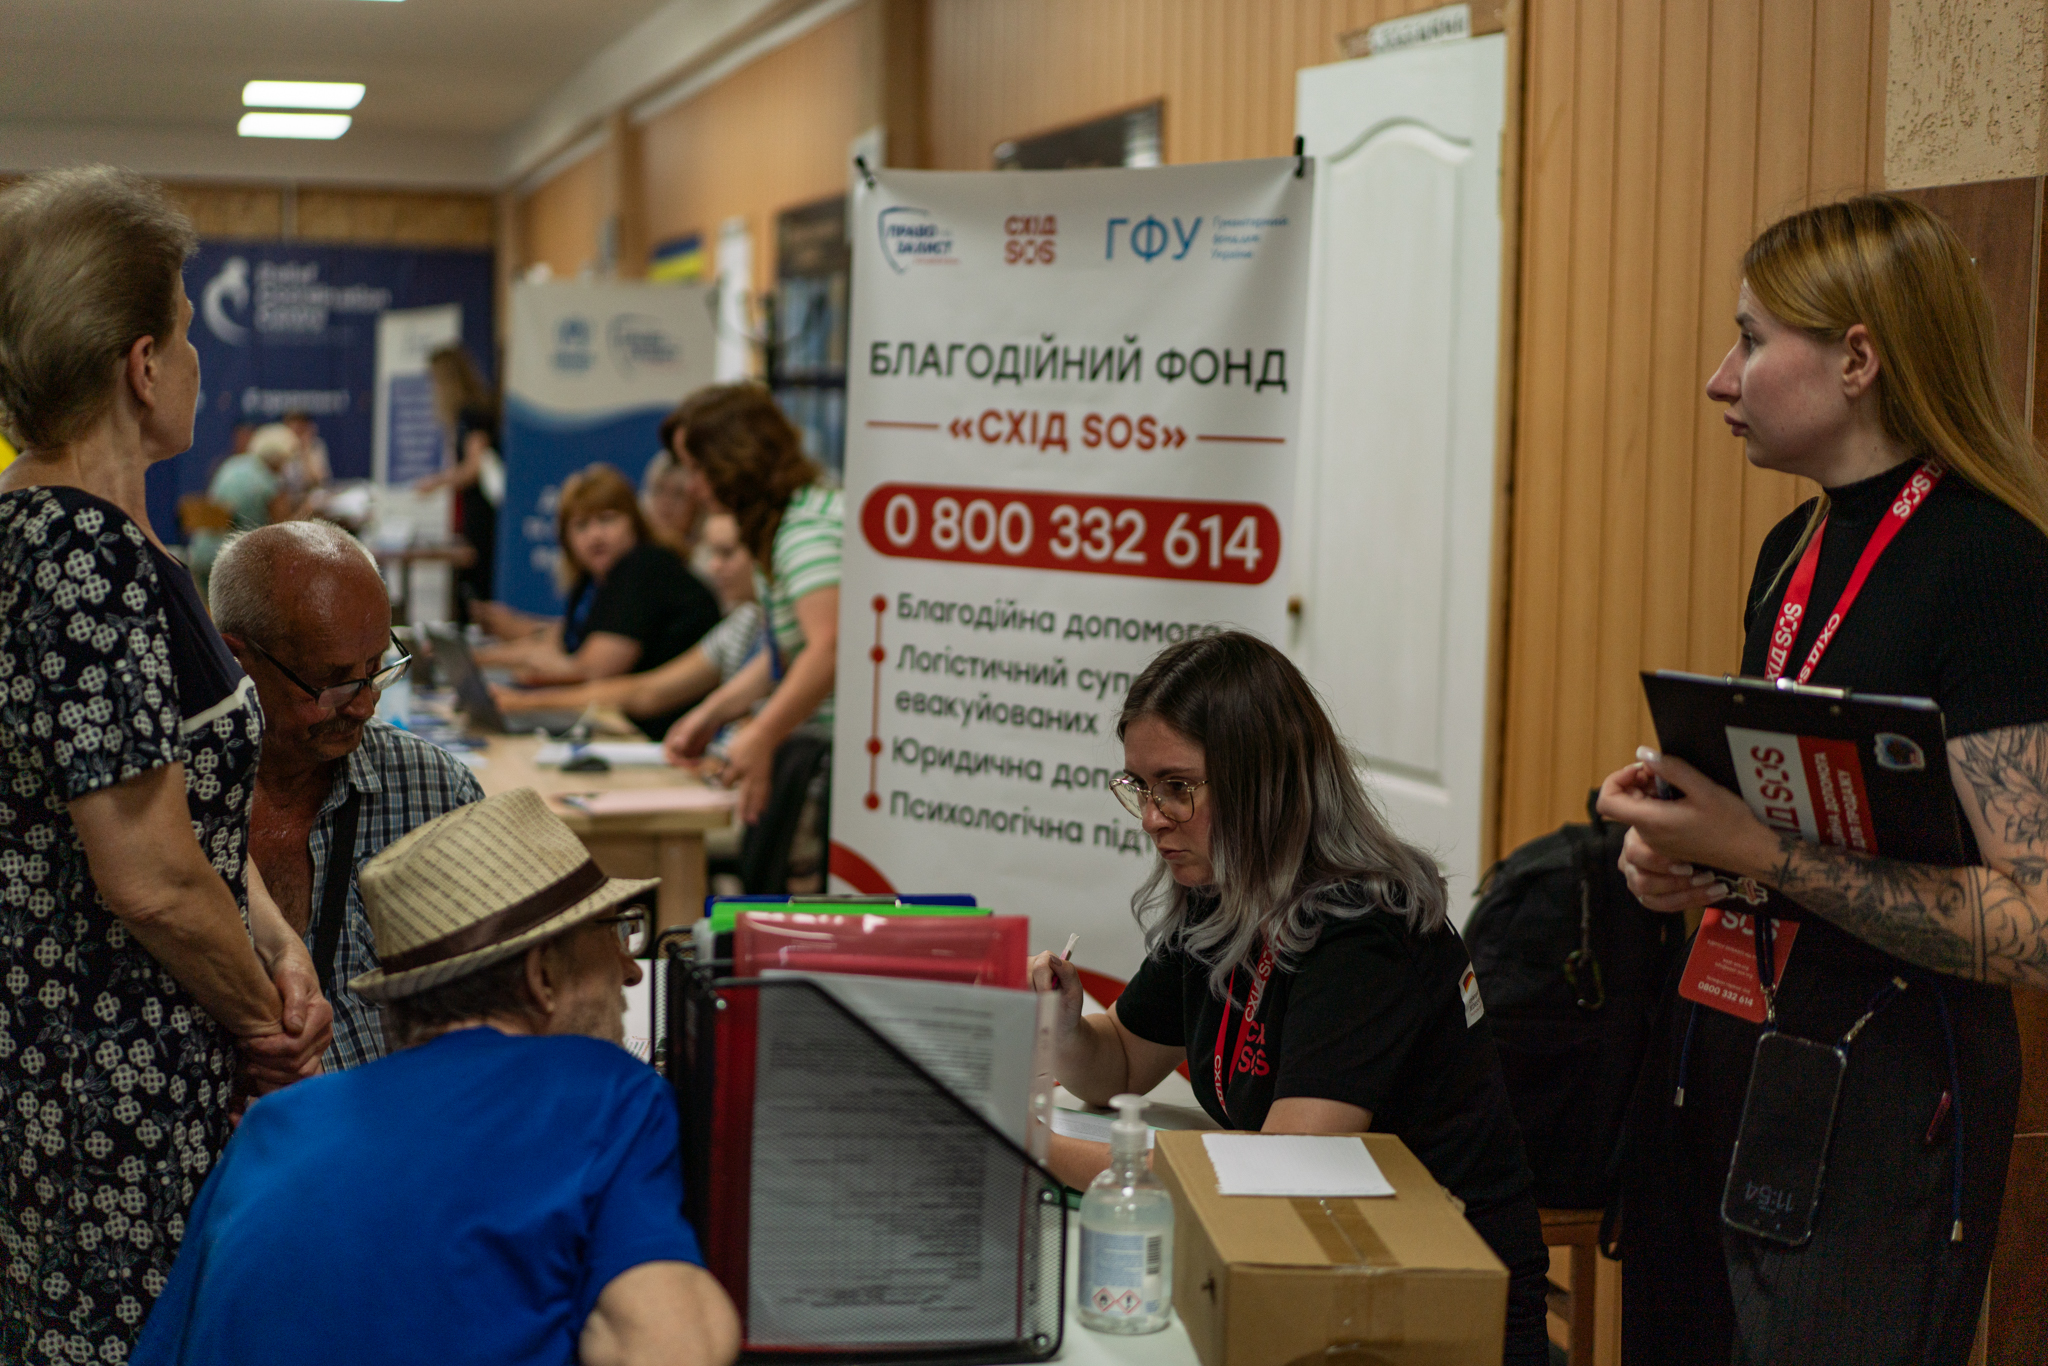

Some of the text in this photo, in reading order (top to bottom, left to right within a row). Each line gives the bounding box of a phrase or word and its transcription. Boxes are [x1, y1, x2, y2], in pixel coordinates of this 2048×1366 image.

[1004, 214, 1057, 236] СХІД
[1105, 214, 1204, 263] ГФУ
[1004, 238, 1057, 265] SOS
[868, 334, 1288, 393] БЛАГОДІЙНИЙ ФОНД
[948, 408, 1187, 452] «СХІД SOS»
[1893, 474, 1931, 518] SOS
[884, 493, 1263, 572] 0 800 332 614
[897, 592, 1056, 633] Благодійна
[1766, 602, 1802, 682] ХІД SOS
[1806, 613, 1841, 664] СХІД
[896, 643, 1069, 688] Логістичний
[895, 690, 1099, 735] евакуйованих
[892, 736, 1043, 782] Юридична
[1751, 745, 1802, 835] ІД SOS
[890, 790, 1084, 844] Психологічна
[1698, 981, 1721, 995] 0800
[1722, 988, 1738, 1002] 332
[1738, 995, 1754, 1007] 614
[1238, 1045, 1270, 1076] SS
